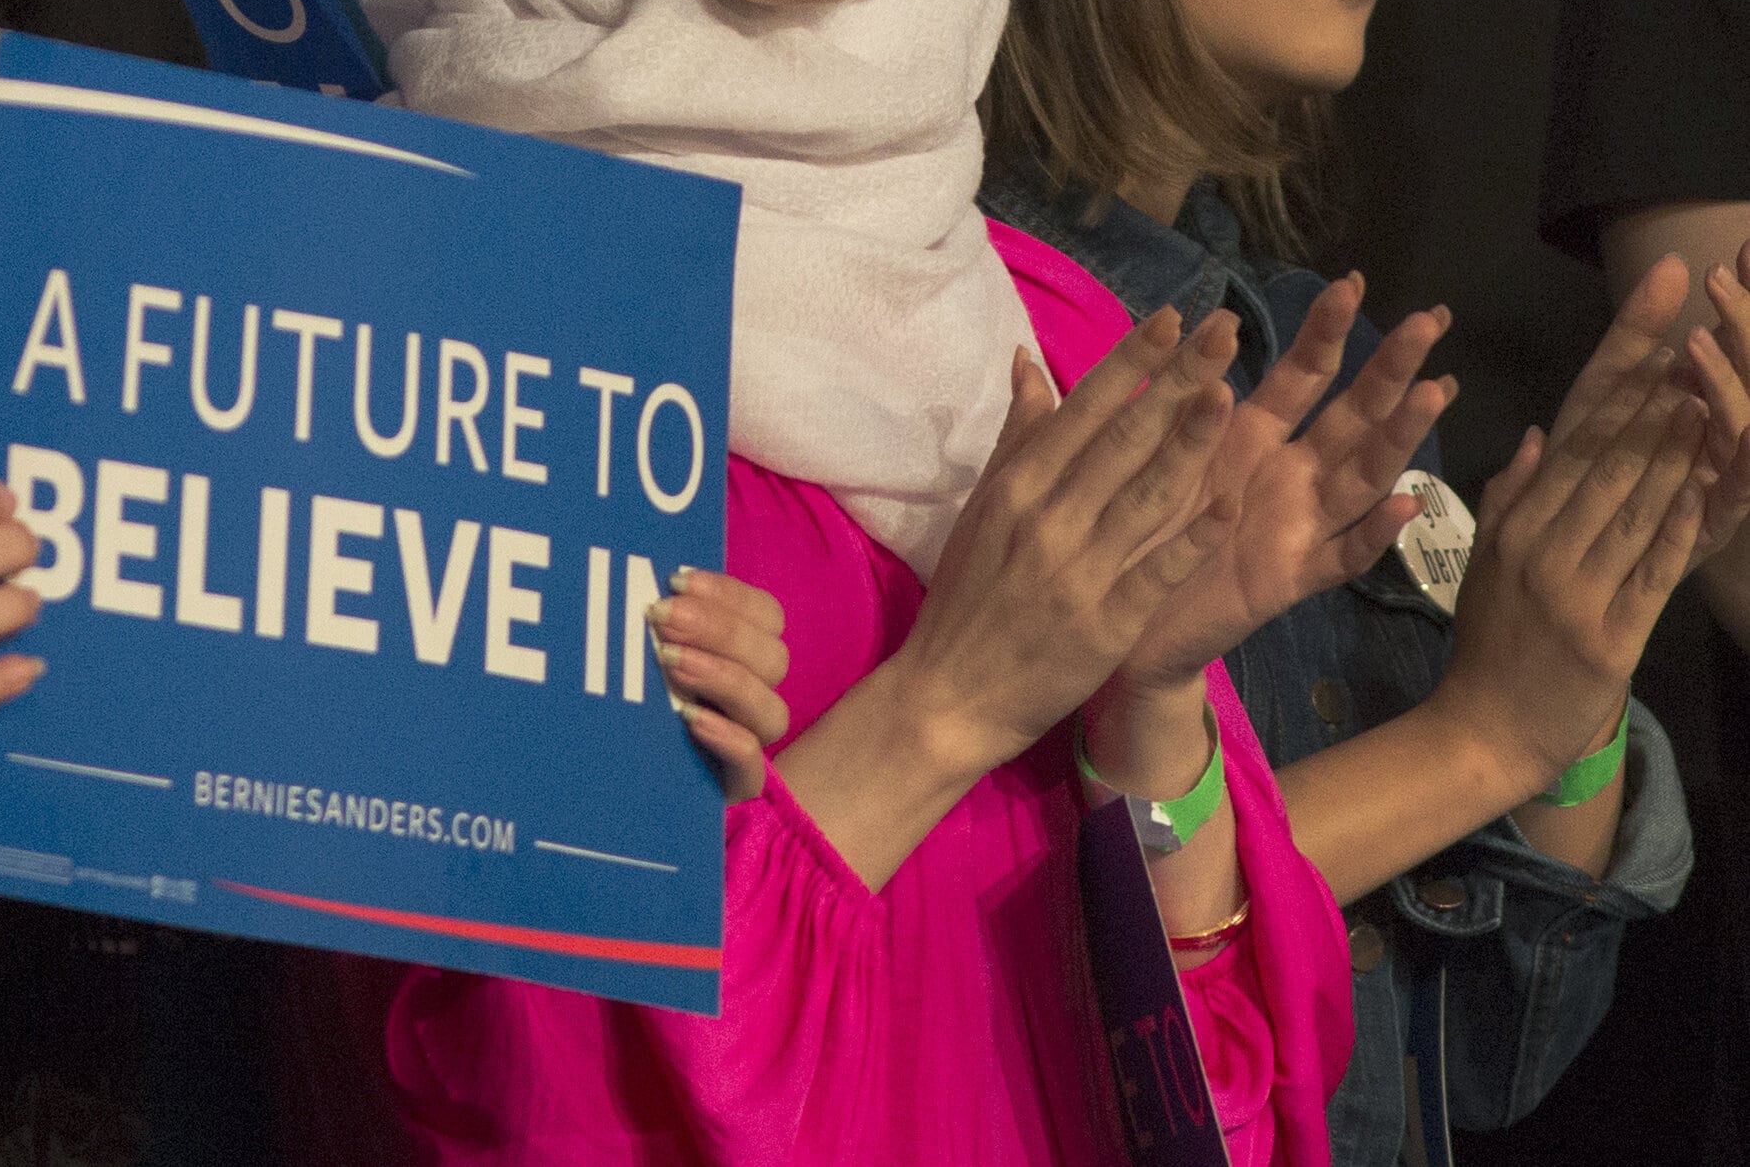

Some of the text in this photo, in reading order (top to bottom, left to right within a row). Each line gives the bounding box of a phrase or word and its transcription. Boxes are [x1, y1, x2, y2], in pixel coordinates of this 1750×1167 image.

[11, 268, 706, 515] A FUTURE TO
[6, 442, 552, 685] BELIEVE
[194, 771, 515, 854] BERNIESANDERS.COM
